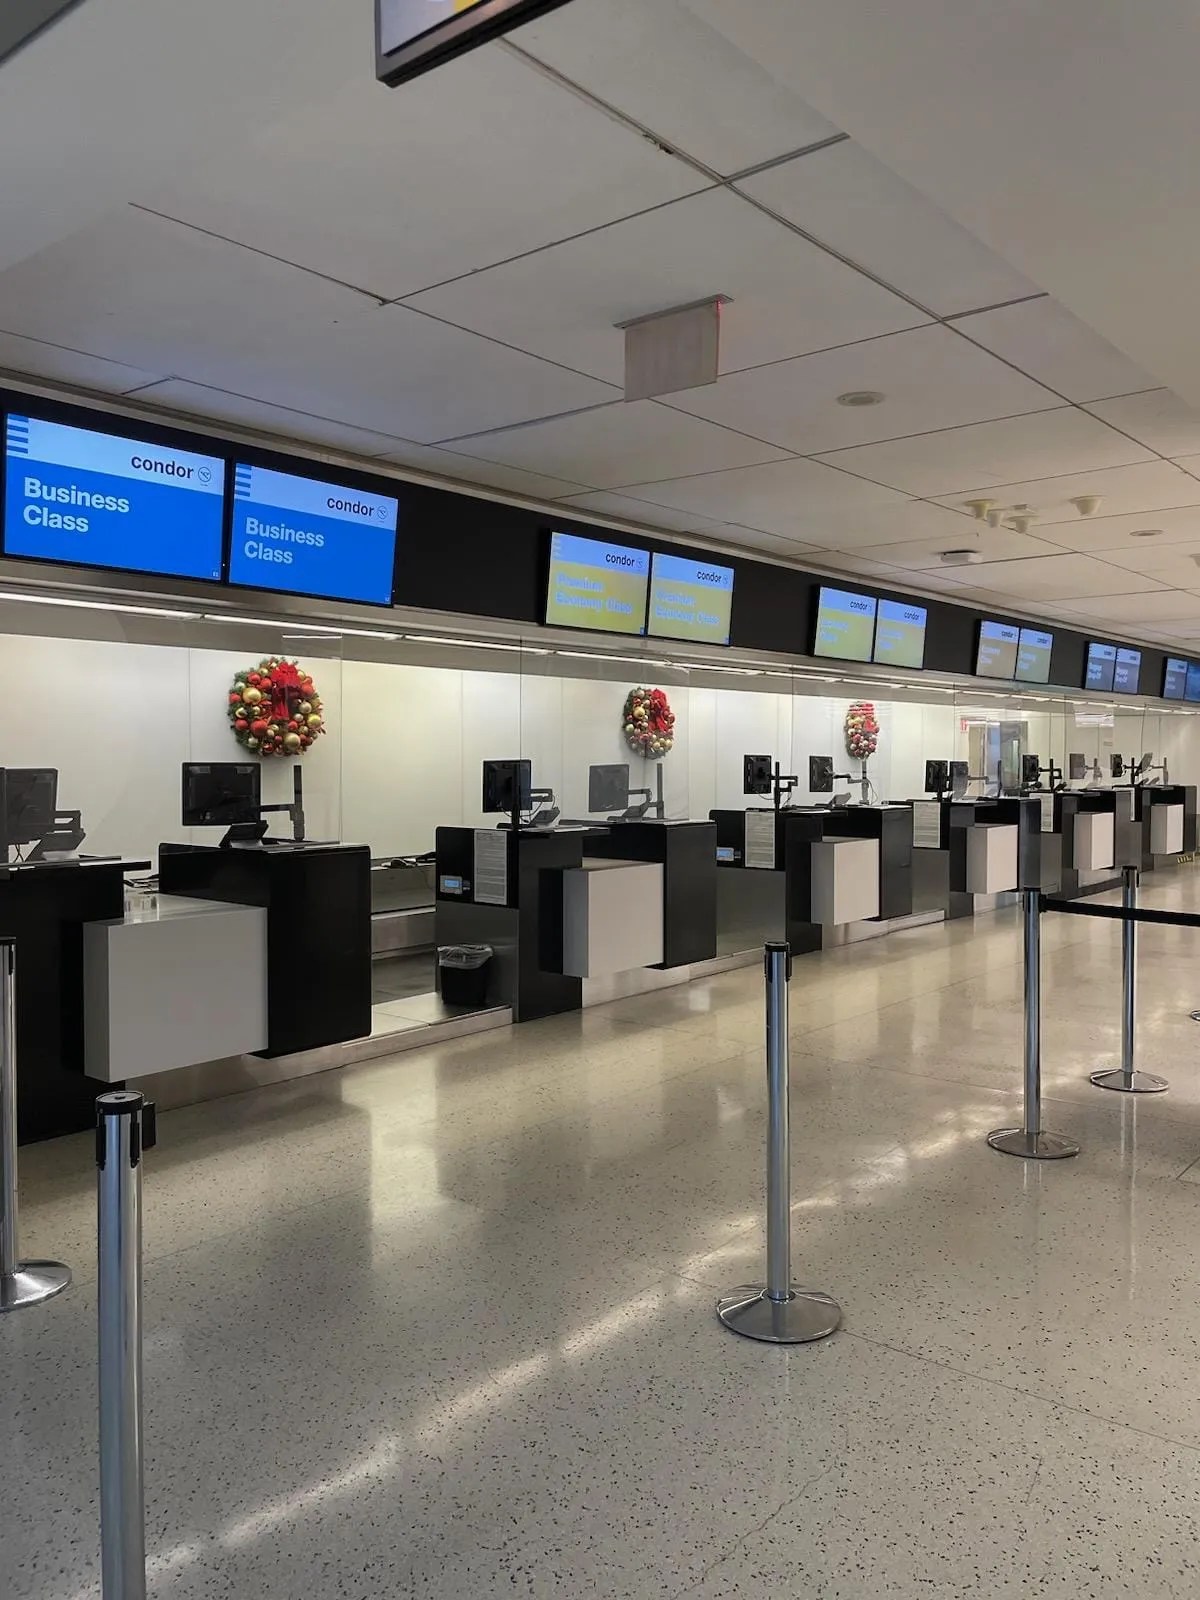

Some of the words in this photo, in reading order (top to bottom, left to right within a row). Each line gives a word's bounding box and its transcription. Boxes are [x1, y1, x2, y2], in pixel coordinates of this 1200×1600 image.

[131, 456, 194, 479] condor
[24, 476, 130, 513] Business
[327, 497, 375, 517] condor
[23, 504, 89, 533] Class
[245, 517, 325, 547] Business
[244, 540, 294, 564] Class
[605, 553, 636, 567] condor
[696, 571, 722, 583] condor
[849, 600, 868, 611] condor
[904, 611, 920, 621] condor
